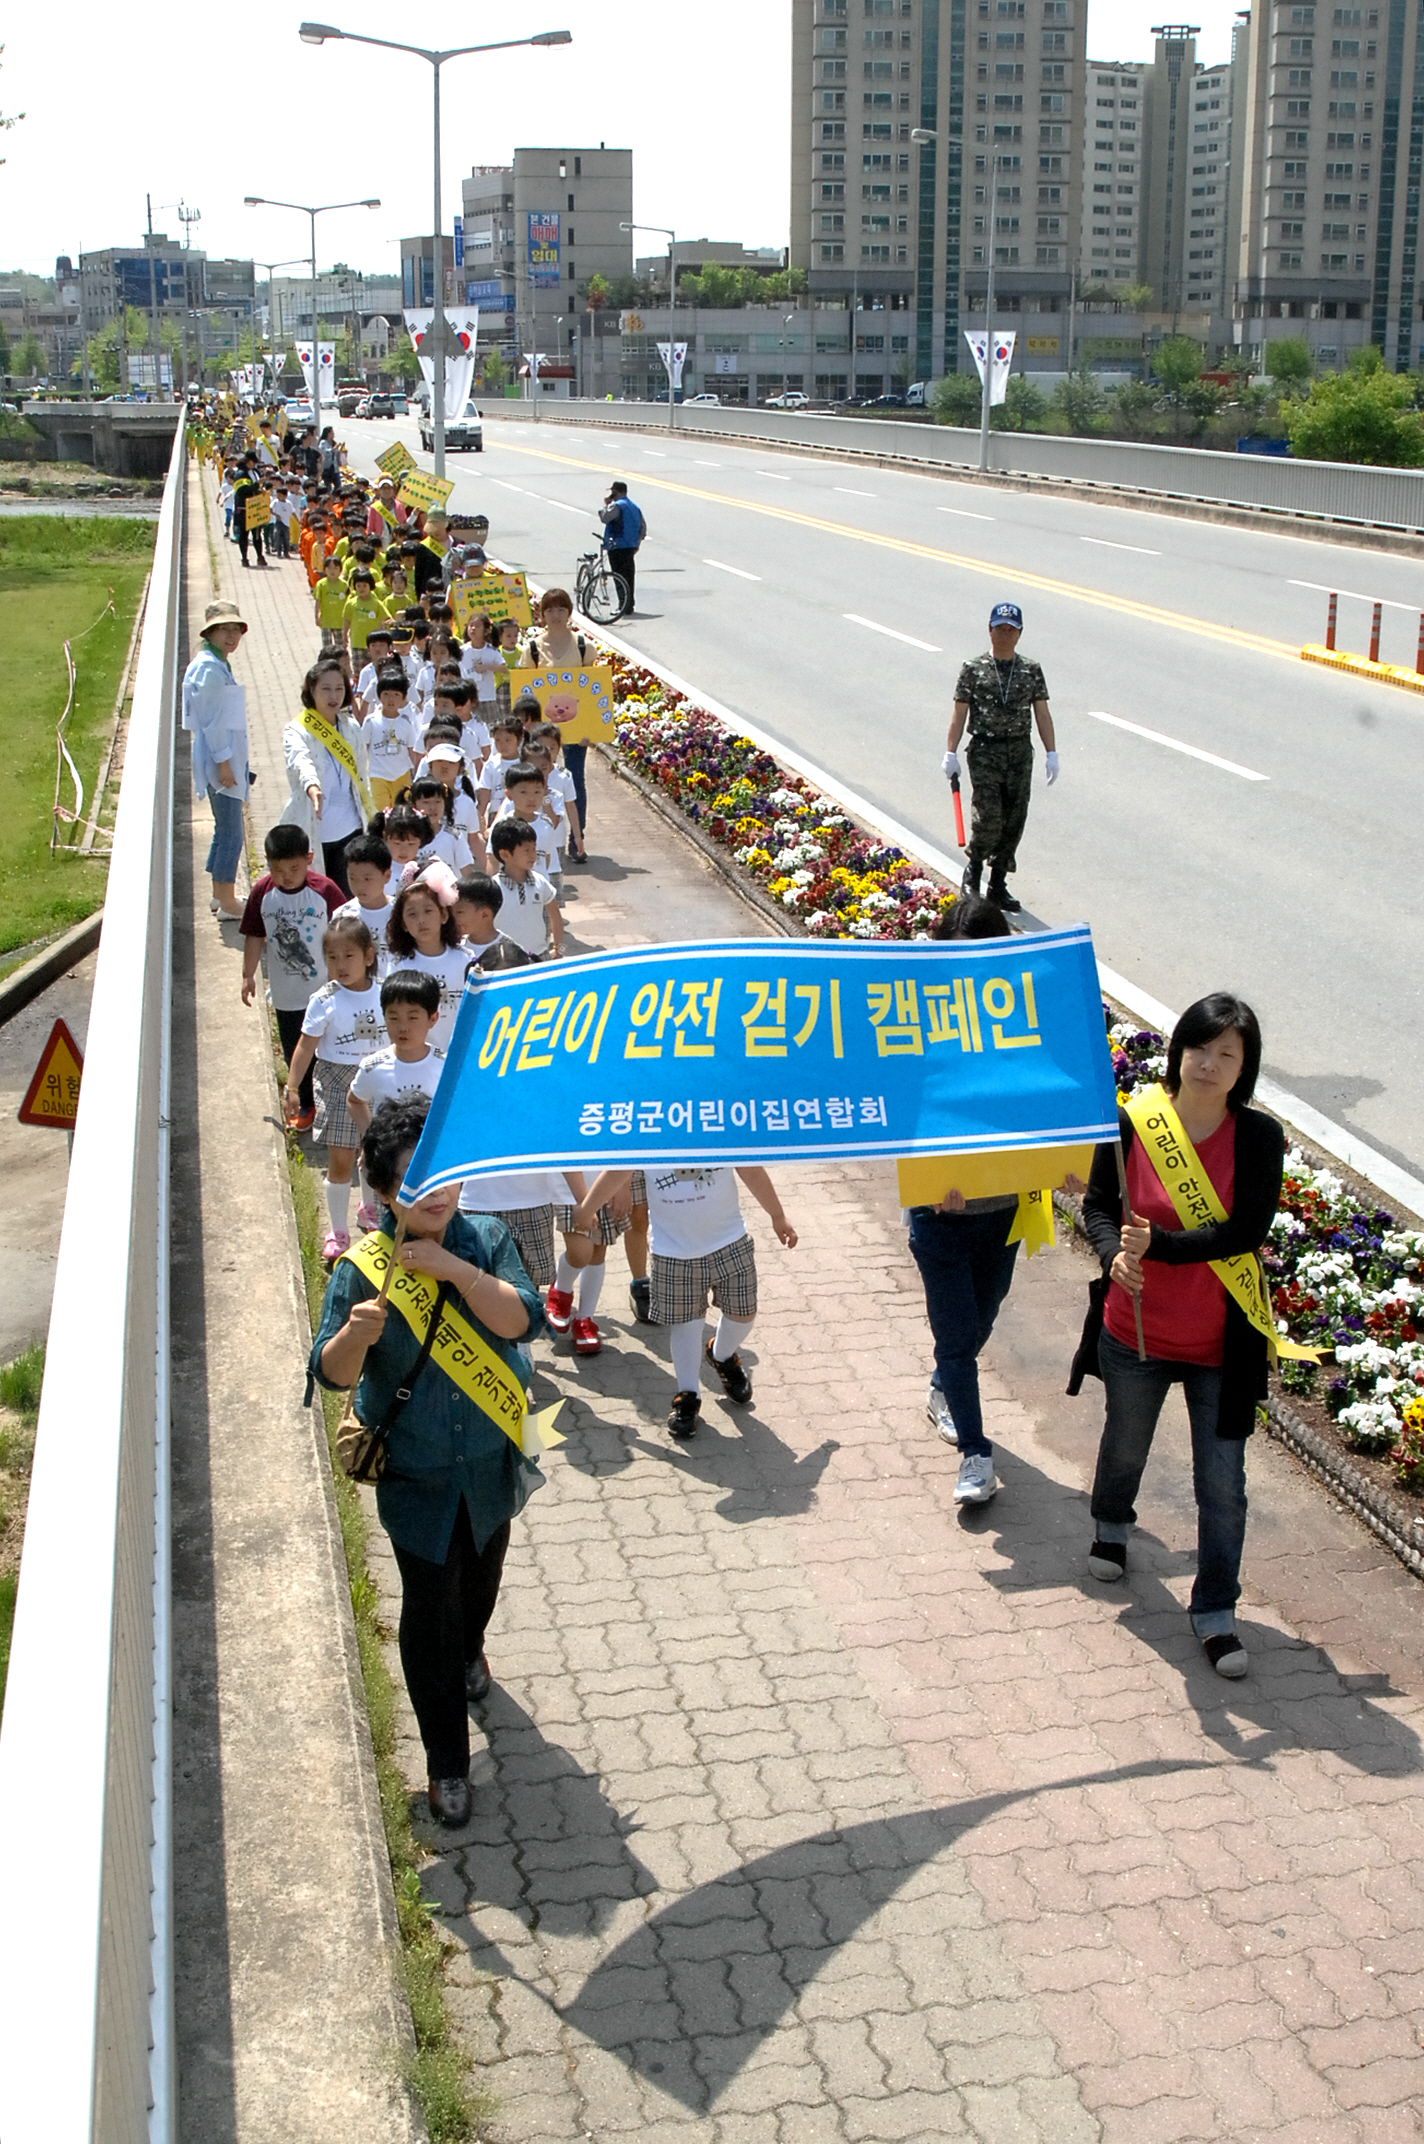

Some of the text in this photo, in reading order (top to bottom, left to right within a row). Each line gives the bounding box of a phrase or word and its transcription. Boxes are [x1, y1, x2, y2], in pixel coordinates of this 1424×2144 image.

[531, 226, 558, 242] 매매
[531, 249, 558, 262] 임대
[604, 320, 617, 328] KB
[648, 363, 662, 371] KB
[304, 712, 333, 738] 어린이
[478, 972, 1041, 1077] 어린이 안전 걷기 캠페인
[579, 1095, 888, 1136] 증평군어린이집연합회
[1146, 1112, 1188, 1169] 어린이
[472, 1364, 523, 1427] 걷기대회
